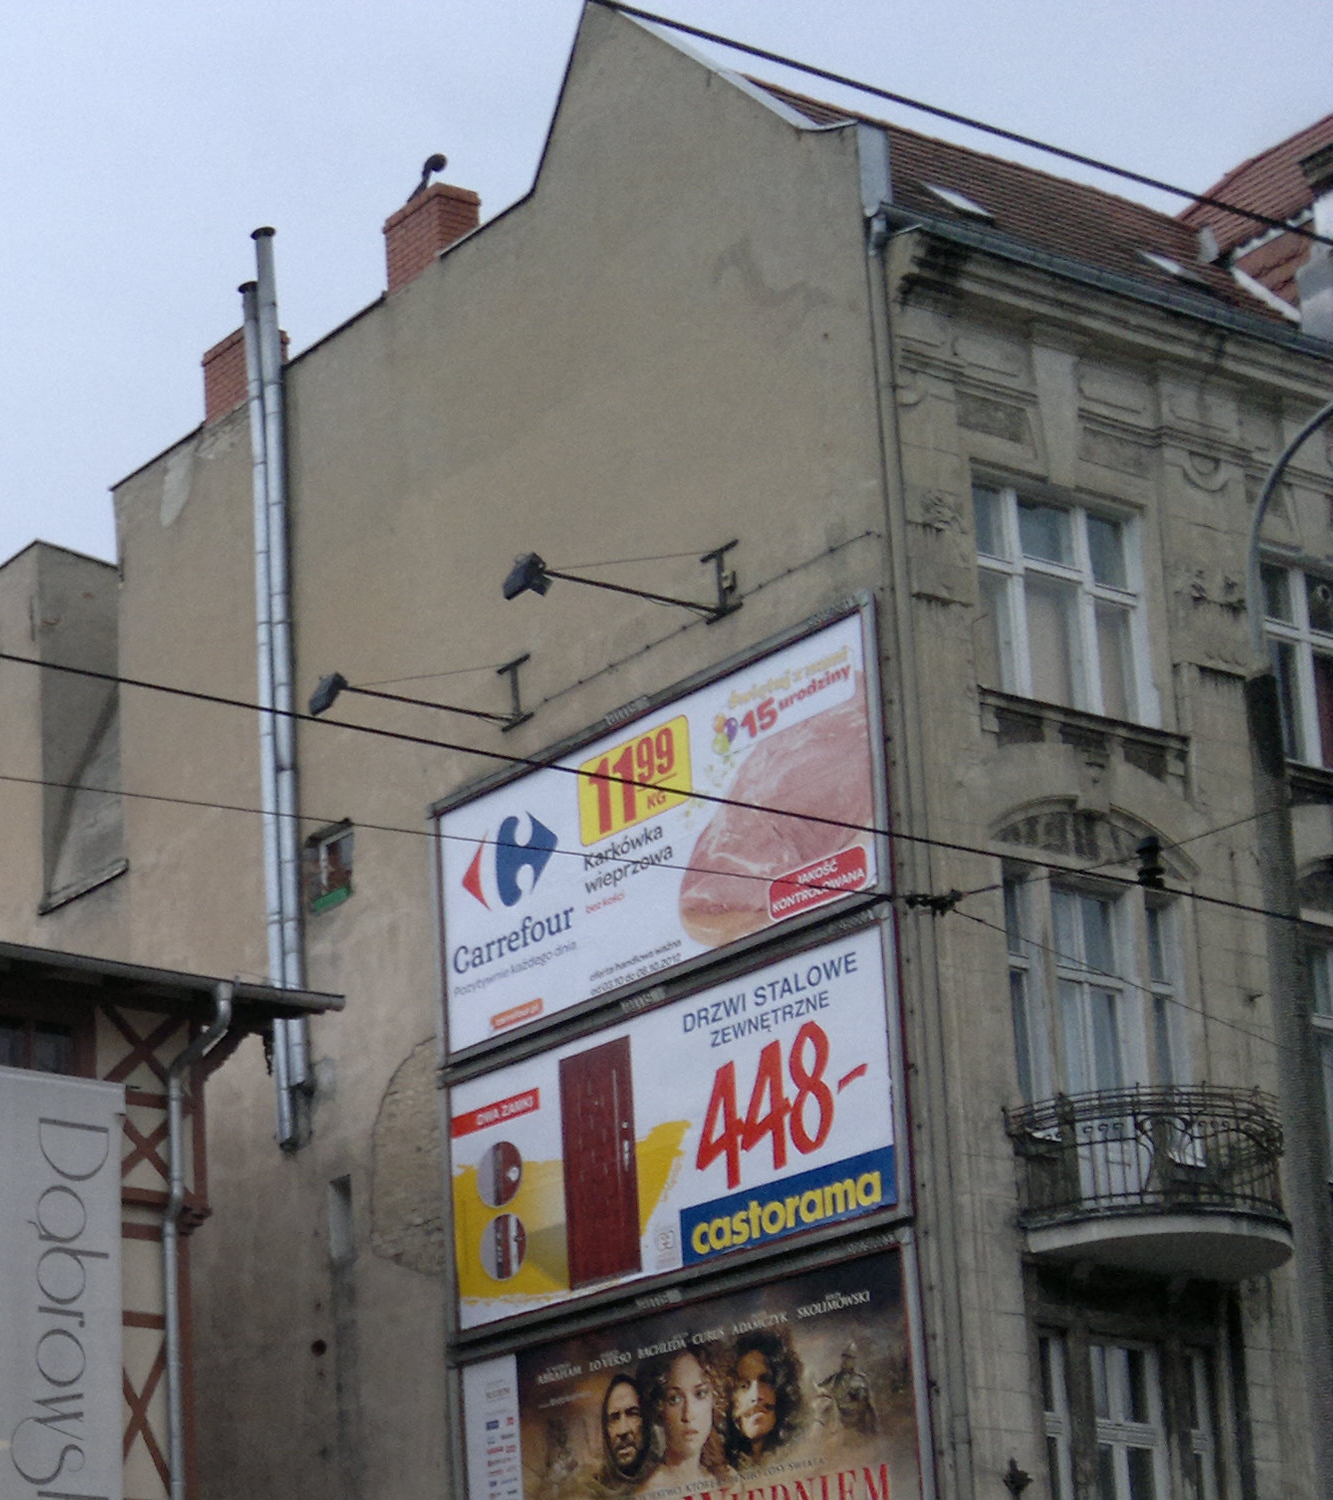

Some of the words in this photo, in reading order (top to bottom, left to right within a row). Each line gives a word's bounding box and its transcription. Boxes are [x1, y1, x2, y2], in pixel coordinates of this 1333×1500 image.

[741, 697, 779, 738] 15
[779, 665, 851, 710] urodziny
[584, 825, 664, 872] Karkówka
[585, 845, 674, 895] wieprzowa
[453, 907, 574, 974] Carrefour
[683, 993, 747, 1034] DRZWI
[754, 952, 858, 1007] STALOWE
[710, 990, 830, 1049] ZEWNĘTRZNE
[692, 1171, 882, 1255] castorama
